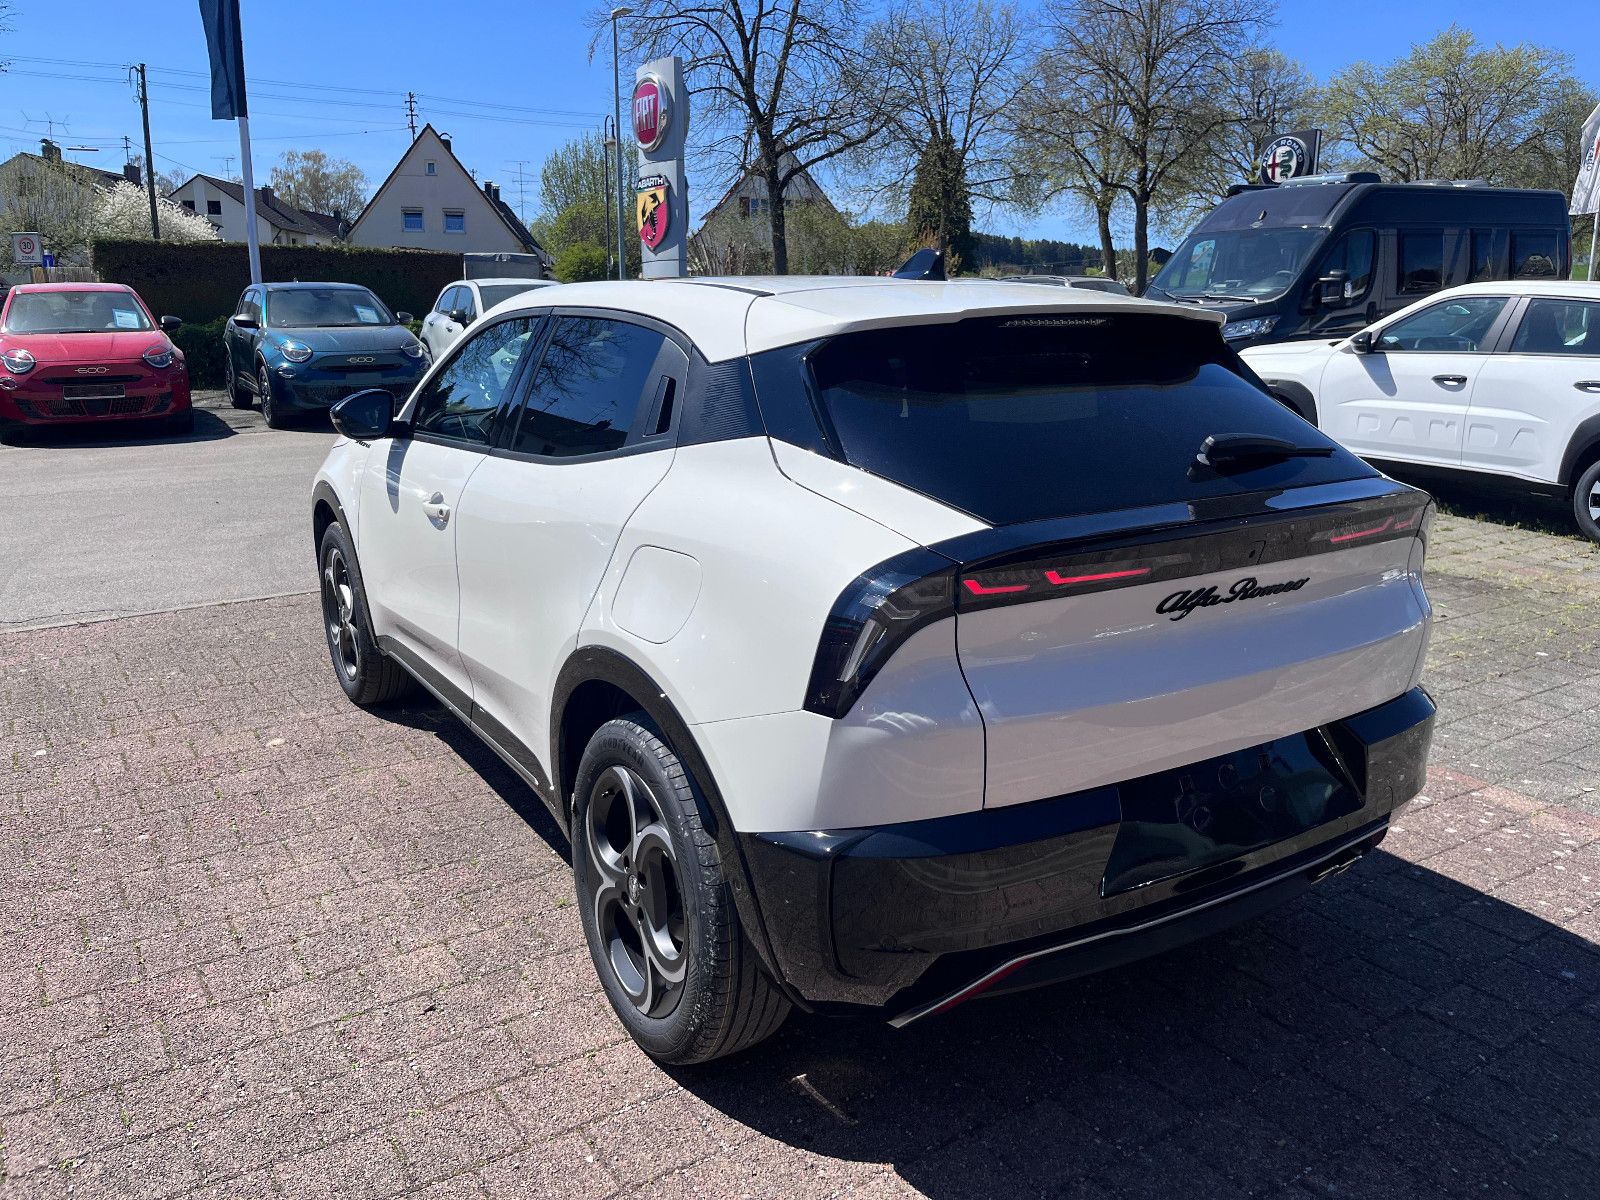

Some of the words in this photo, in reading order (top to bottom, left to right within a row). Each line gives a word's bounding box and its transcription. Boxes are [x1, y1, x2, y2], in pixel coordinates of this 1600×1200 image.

[636, 94, 656, 132] FIAT
[1263, 144, 1277, 168] ALFA
[1280, 140, 1304, 163] ROMEO
[637, 177, 664, 189] ABARTH
[21, 241, 32, 250] 30
[1155, 585, 1224, 622] Alfa
[1228, 576, 1311, 601] Romeo
